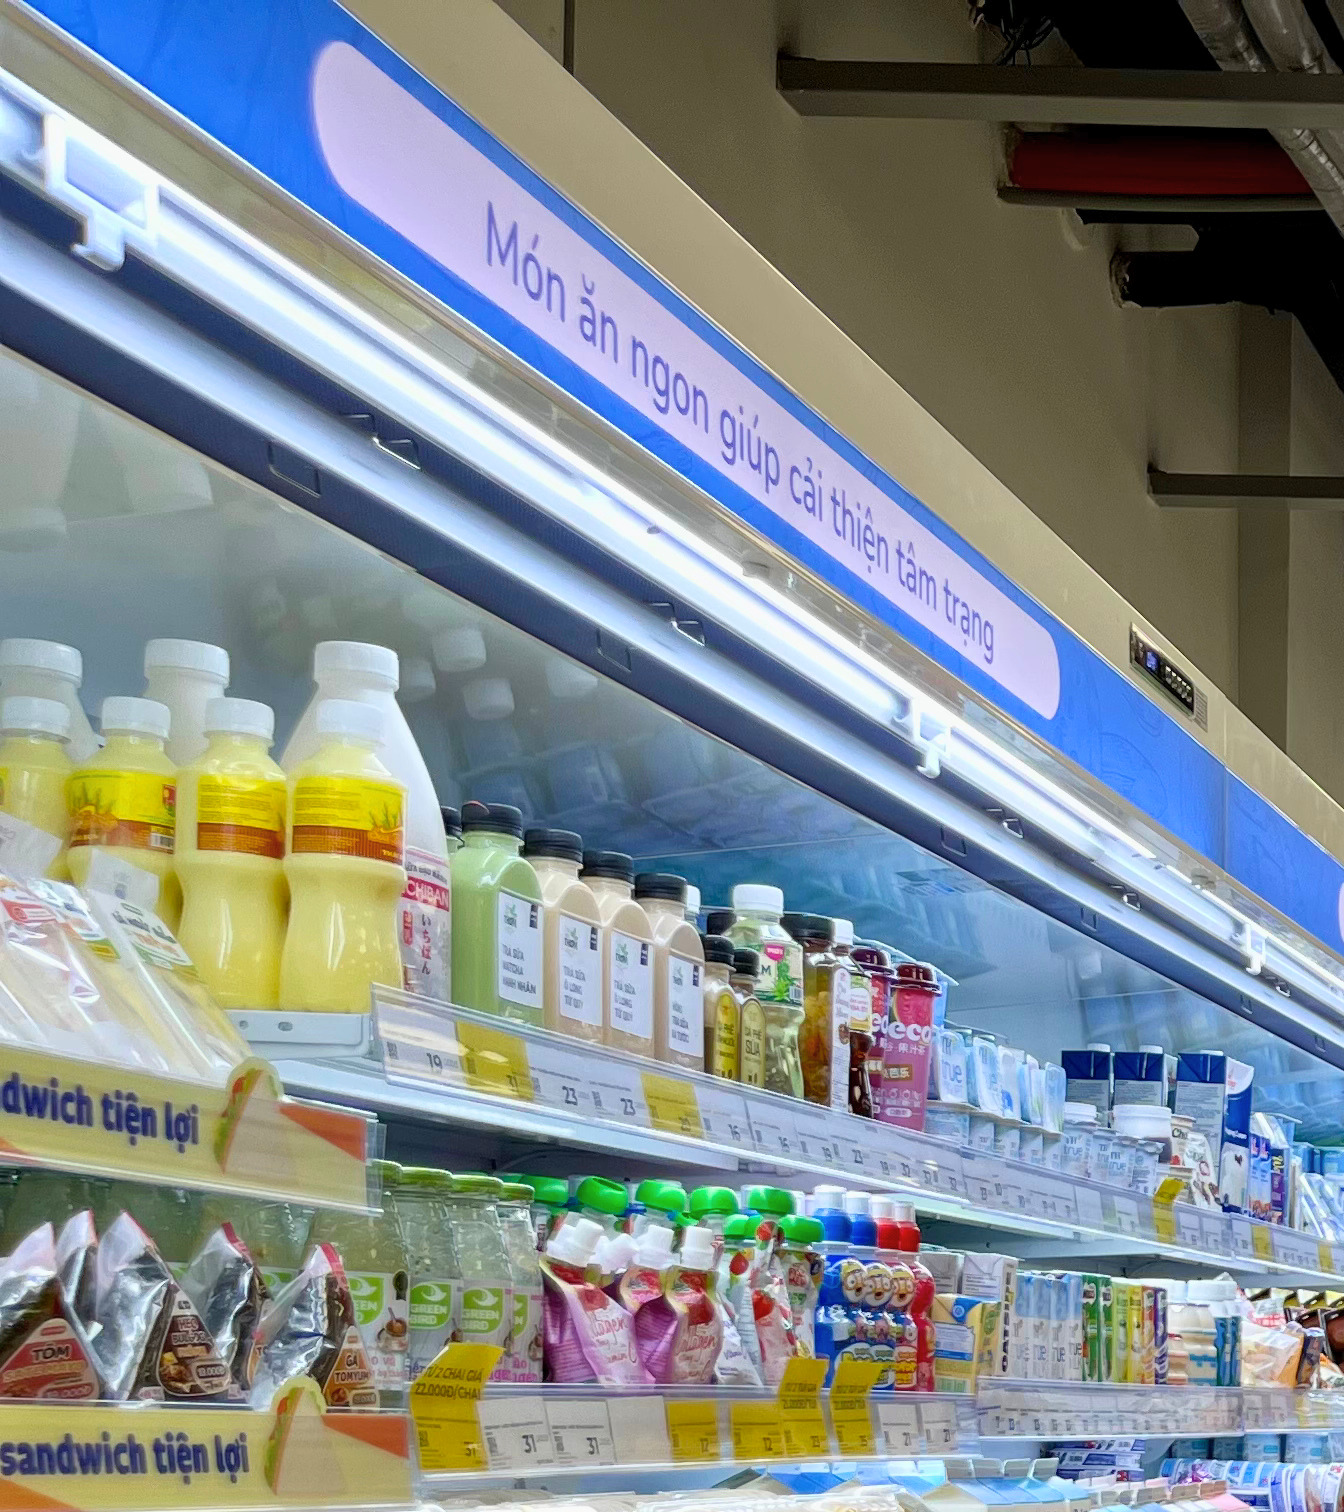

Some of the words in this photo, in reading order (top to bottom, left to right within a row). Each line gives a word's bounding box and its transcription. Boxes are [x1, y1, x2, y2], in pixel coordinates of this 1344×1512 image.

[485, 200, 566, 322] Món
[579, 274, 618, 363] ăn
[631, 336, 709, 434] ngon
[719, 403, 781, 491] giúp
[788, 457, 824, 523] cải
[830, 488, 889, 574] thiện
[895, 539, 937, 611] tâm
[943, 577, 995, 665] trạng
[405, 880, 450, 911] CHIBAN
[427, 1052, 443, 1075] 19
[562, 1086, 577, 1105] 23
[1, 1073, 94, 1127] dwich
[102, 1091, 156, 1147] tiện
[164, 1097, 199, 1158] lợi
[620, 1098, 635, 1115] 23
[410, 1303, 448, 1315] GREEN
[409, 1314, 437, 1325] BIRD
[32, 1342, 71, 1361] TÔM
[522, 1435, 536, 1453] 31
[586, 1437, 599, 1455] 31
[0, 1431, 147, 1476] sandwich
[153, 1431, 209, 1485] tiện
[214, 1432, 249, 1484] lợi
